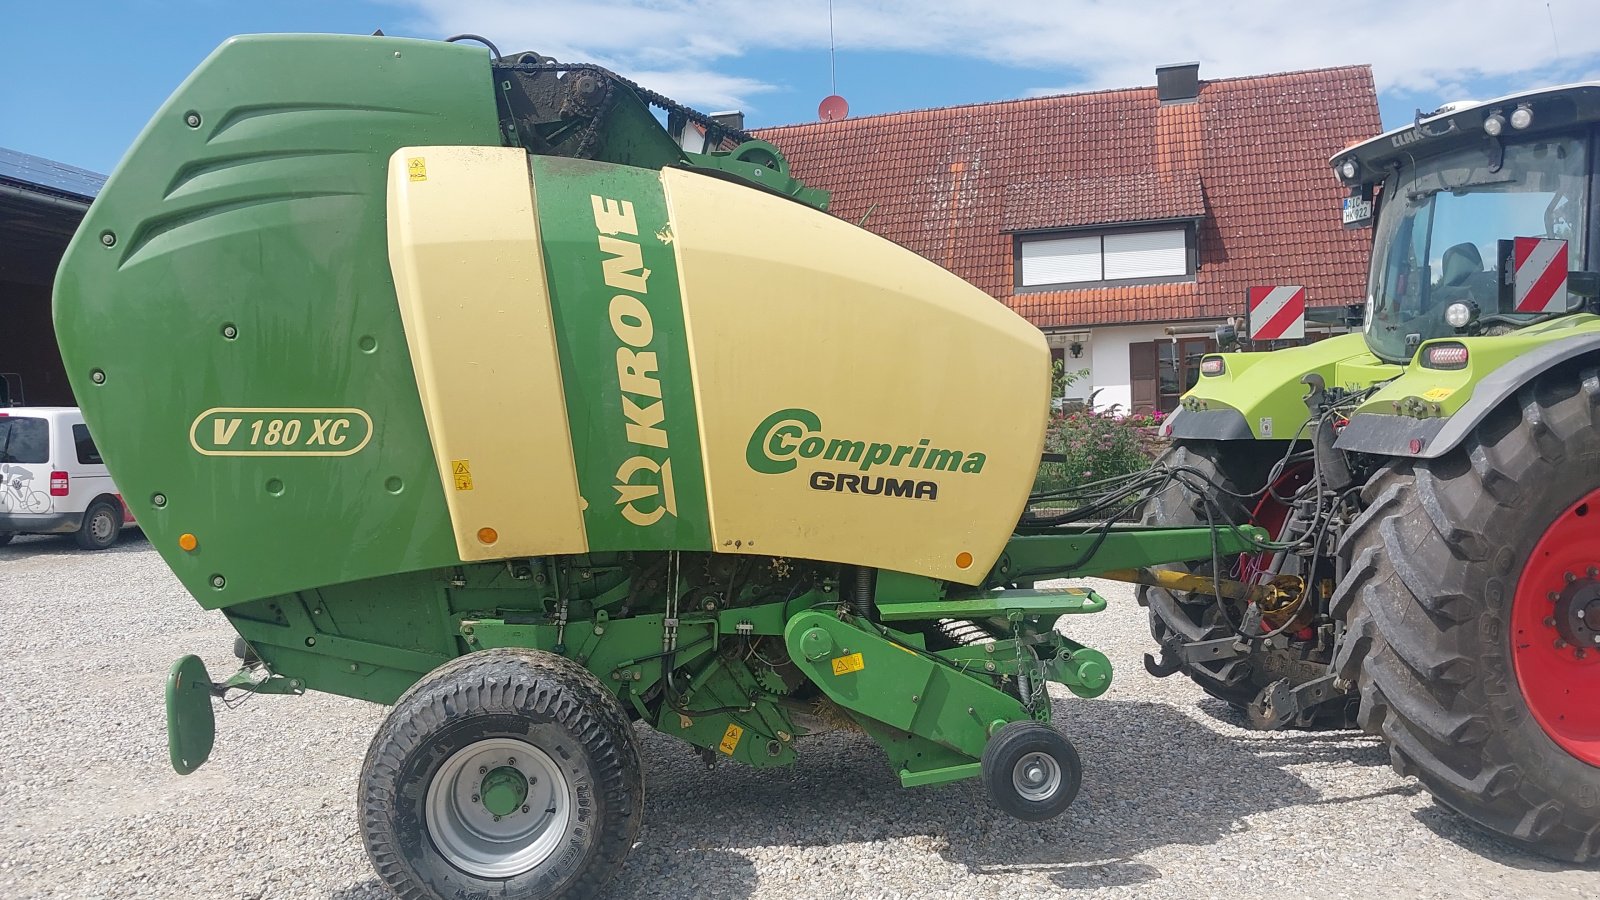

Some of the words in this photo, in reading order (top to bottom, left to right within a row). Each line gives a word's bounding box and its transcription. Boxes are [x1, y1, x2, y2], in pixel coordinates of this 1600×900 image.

[590, 194, 669, 449] KRONE
[213, 418, 243, 445] V
[250, 419, 301, 446] 180
[305, 418, 350, 446] XC
[745, 408, 987, 475] Comprima
[809, 471, 938, 500] GRUMA
